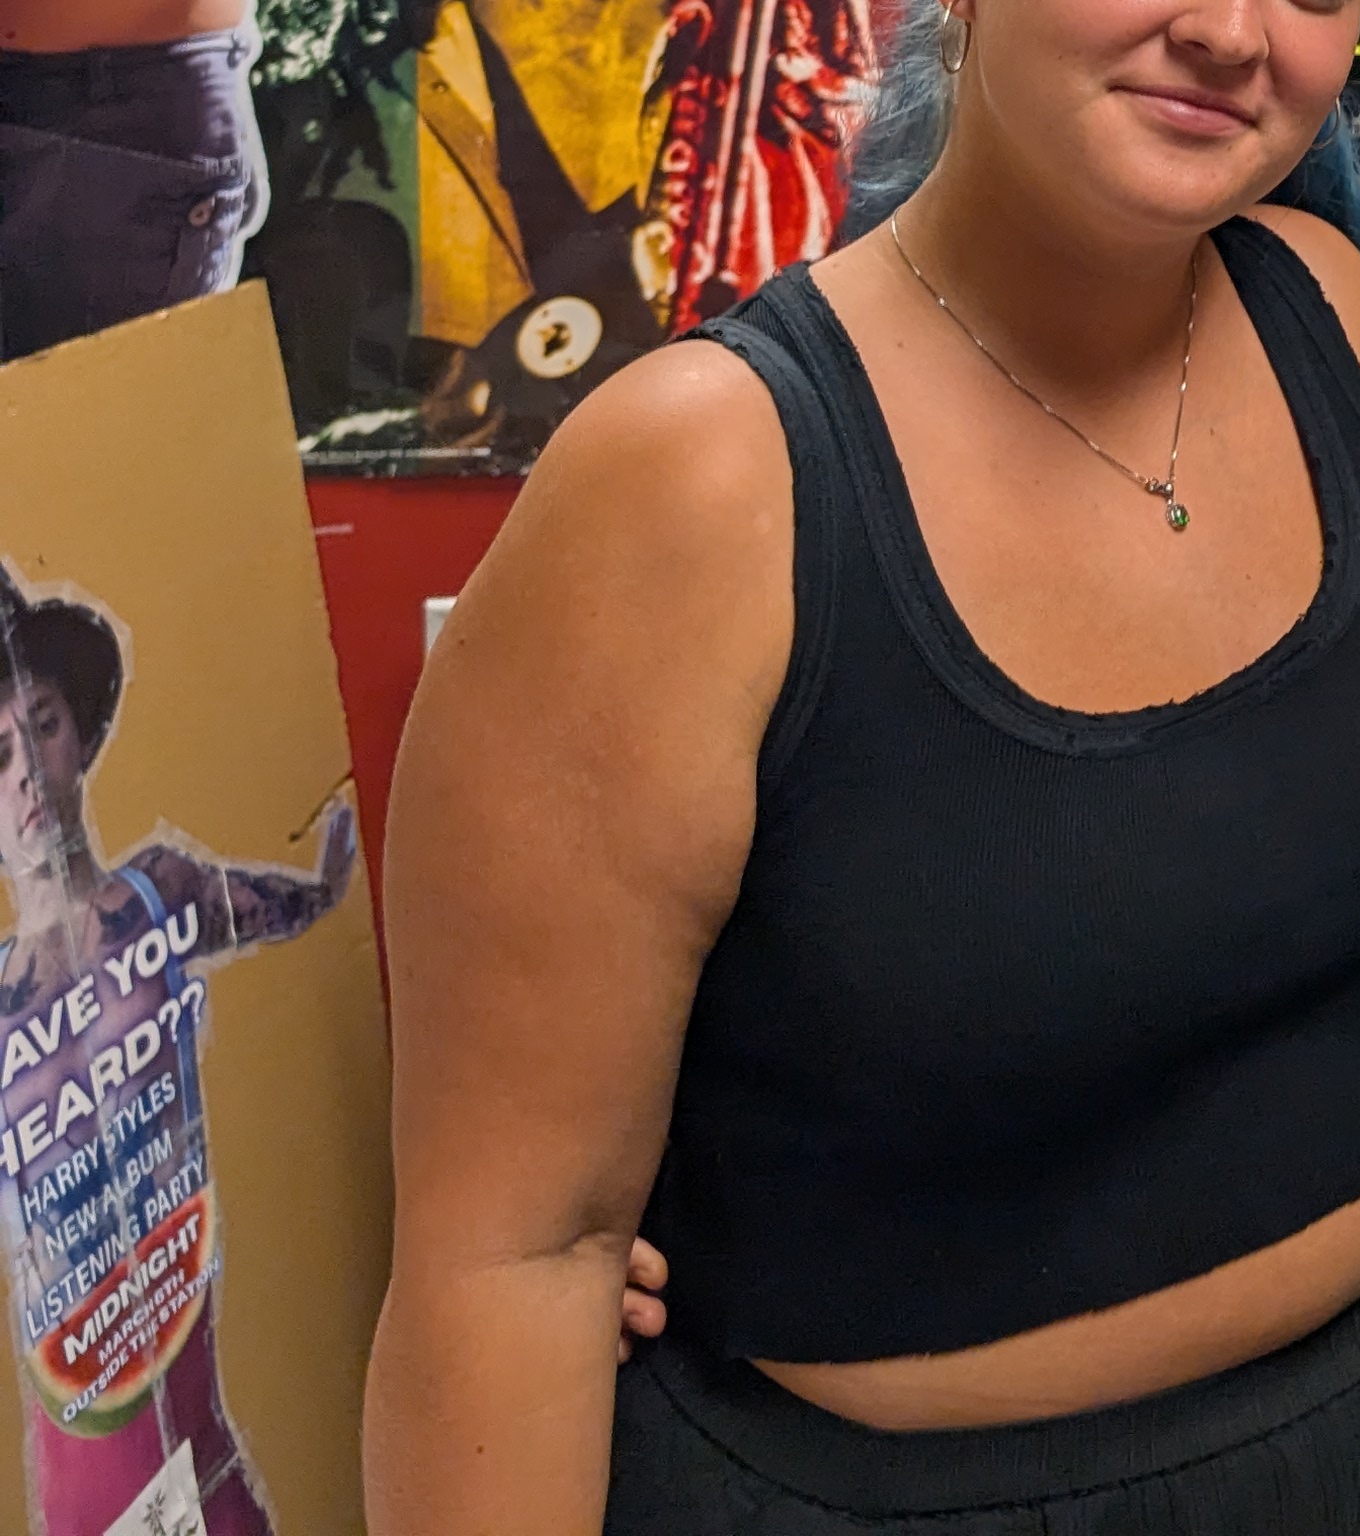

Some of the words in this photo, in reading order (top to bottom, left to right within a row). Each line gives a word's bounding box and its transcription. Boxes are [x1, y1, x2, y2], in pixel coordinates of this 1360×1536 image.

[0, 974, 100, 1090] AVE
[104, 902, 199, 997] YOU
[23, 1136, 101, 1222] HARRY
[101, 1071, 176, 1154] STYLES
[45, 1196, 100, 1263] NEW
[101, 1128, 174, 1212] ALBUM
[26, 1213, 141, 1340] LISTENING
[145, 1157, 206, 1233] PARTY
[62, 1213, 200, 1365] MIDNIGHT
[61, 1346, 130, 1423] OUTSIDE
[158, 1259, 221, 1325] STATION
[98, 1298, 156, 1366] MARCH
